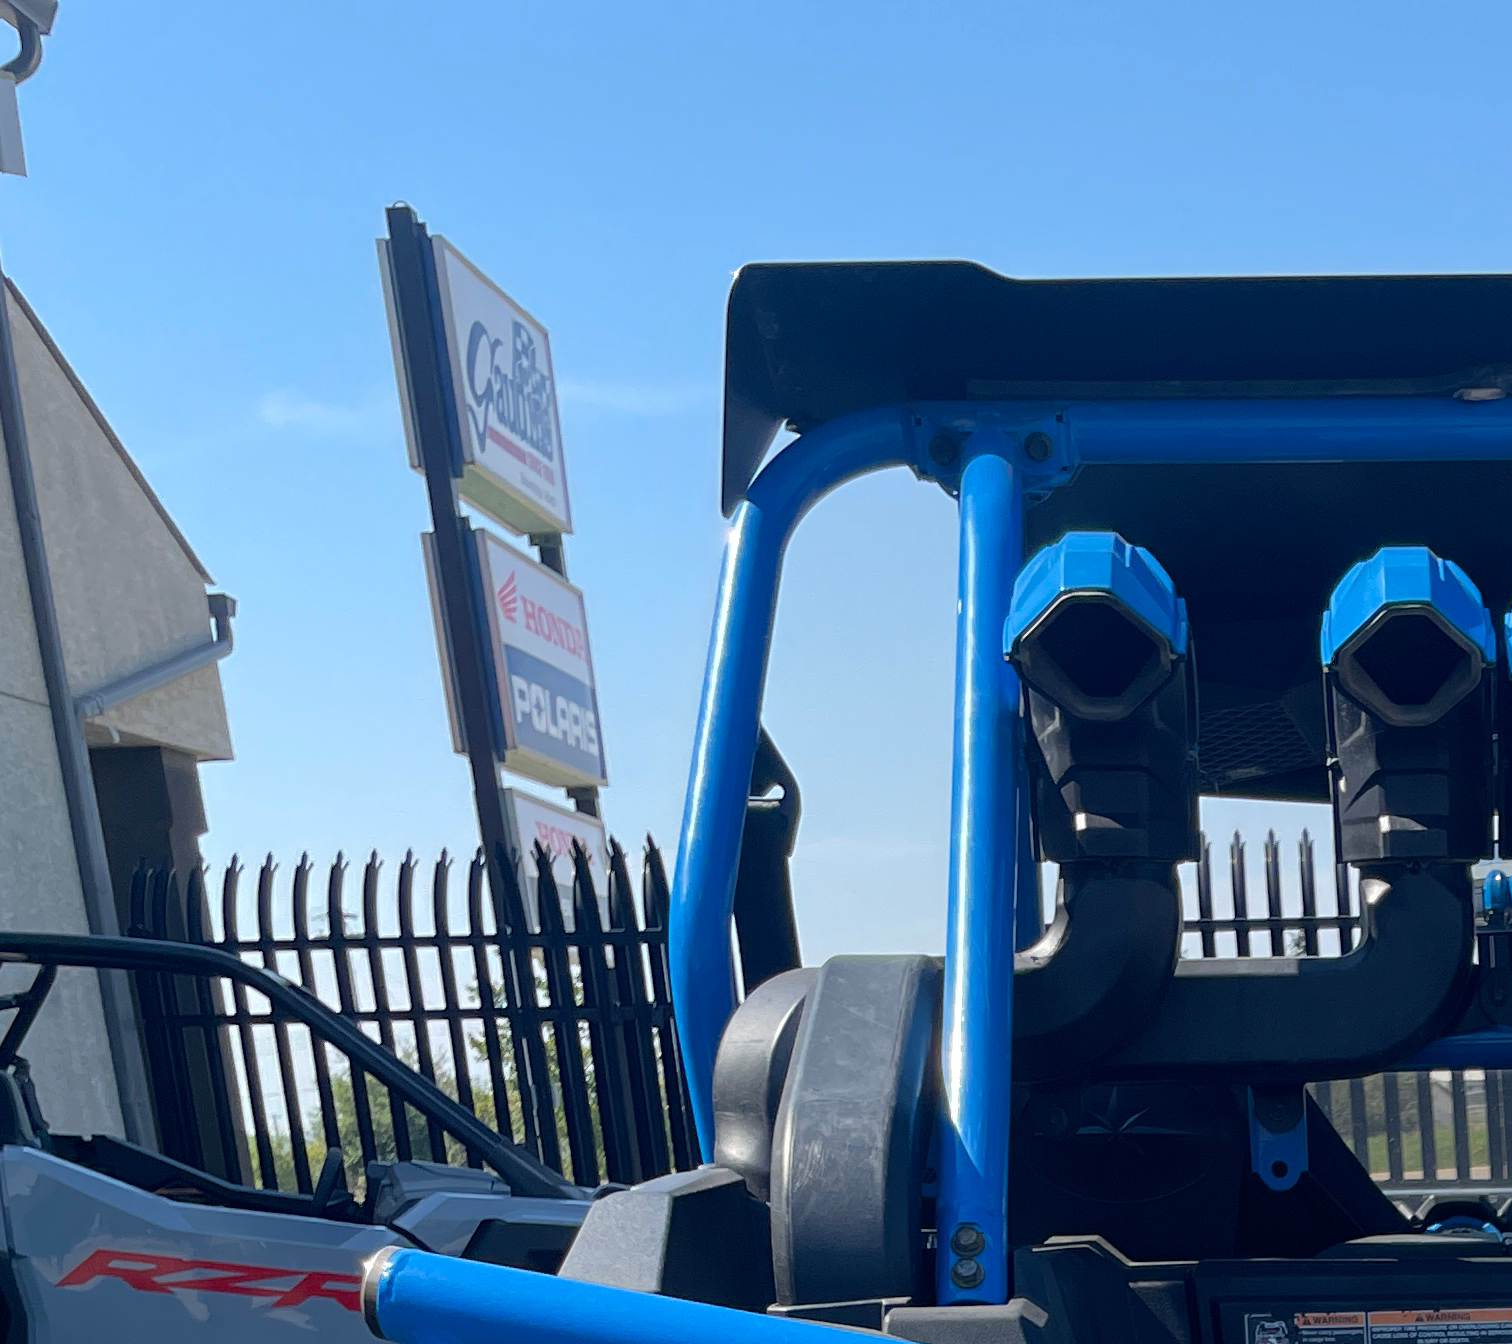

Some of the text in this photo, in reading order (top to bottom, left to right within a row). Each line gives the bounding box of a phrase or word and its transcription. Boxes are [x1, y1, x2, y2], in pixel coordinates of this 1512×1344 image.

[521, 594, 586, 661] HONDA
[511, 675, 599, 757] POLARIS
[55, 1248, 363, 1312] RZR
[1313, 1315, 1358, 1325] WARNING
[1425, 1312, 1471, 1322] WARNING
